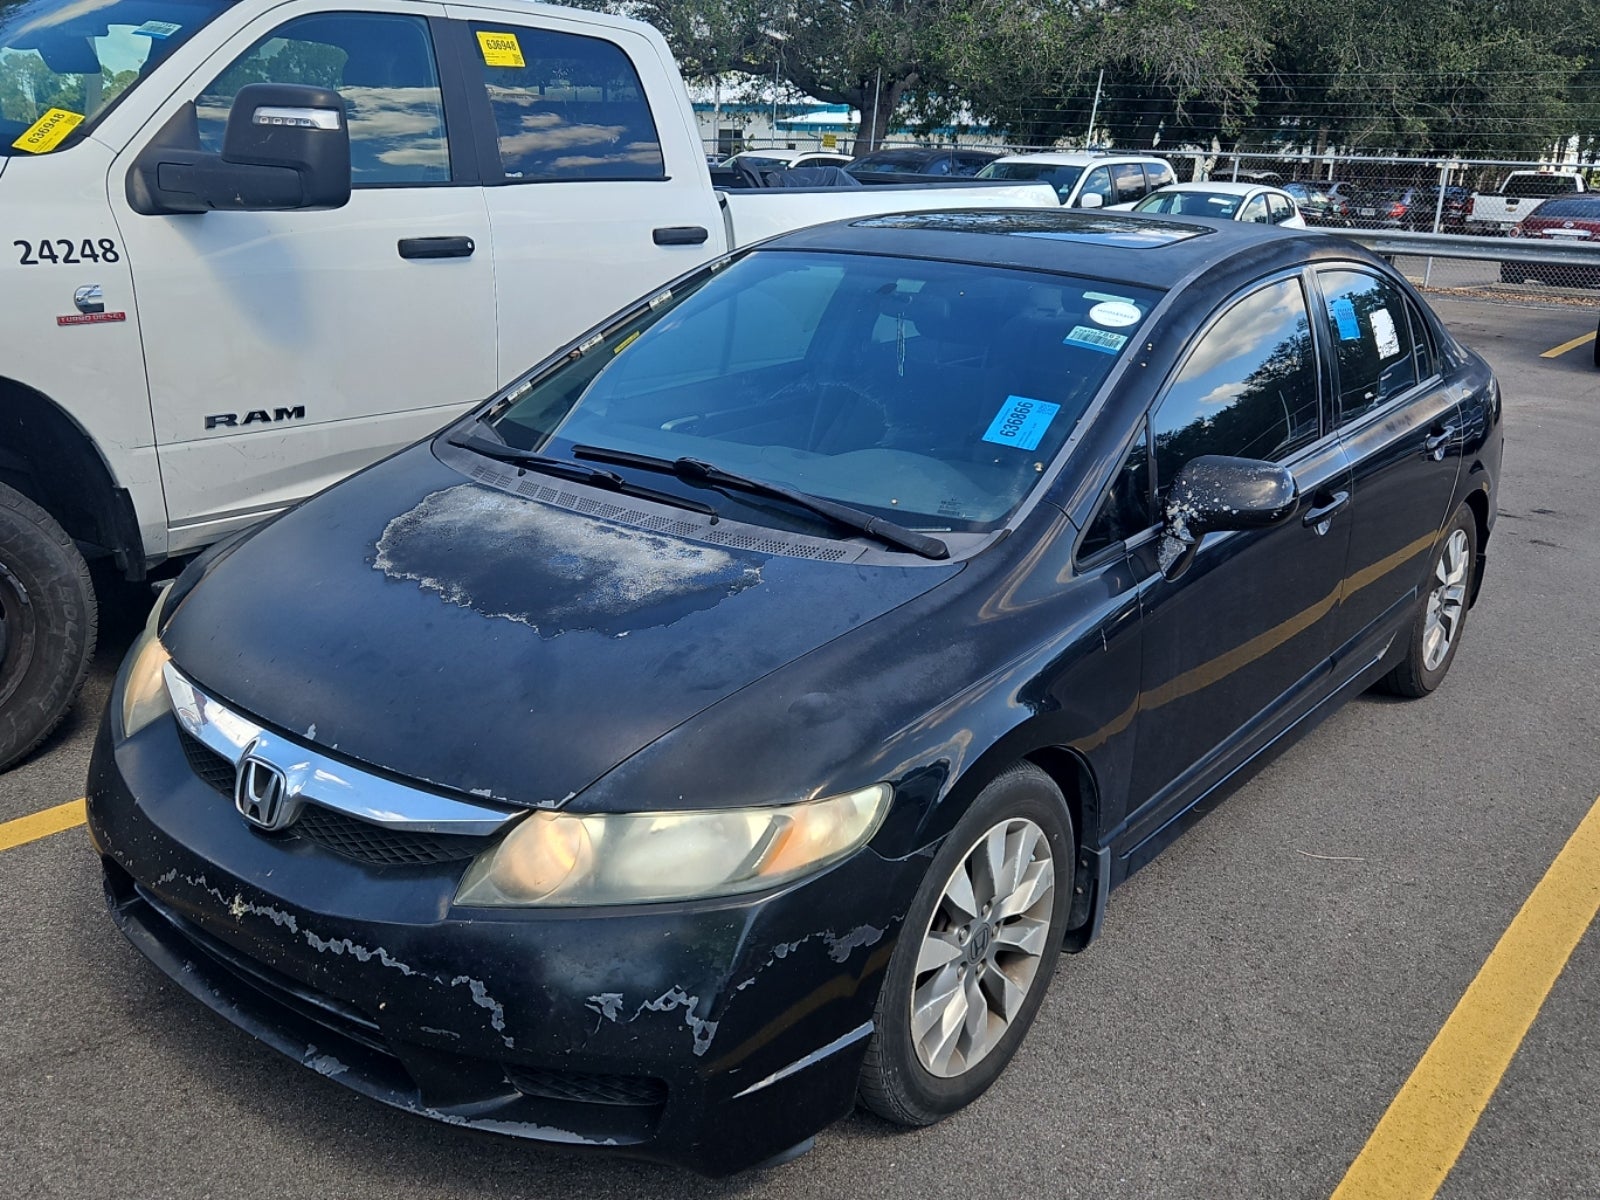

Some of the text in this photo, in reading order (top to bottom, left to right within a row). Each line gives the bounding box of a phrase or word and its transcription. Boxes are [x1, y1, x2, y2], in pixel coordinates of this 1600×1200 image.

[486, 39, 517, 50] 636948
[27, 113, 65, 143] 636948
[13, 238, 120, 265] 24248
[204, 405, 305, 429] RAM
[1000, 401, 1034, 437] 636866
